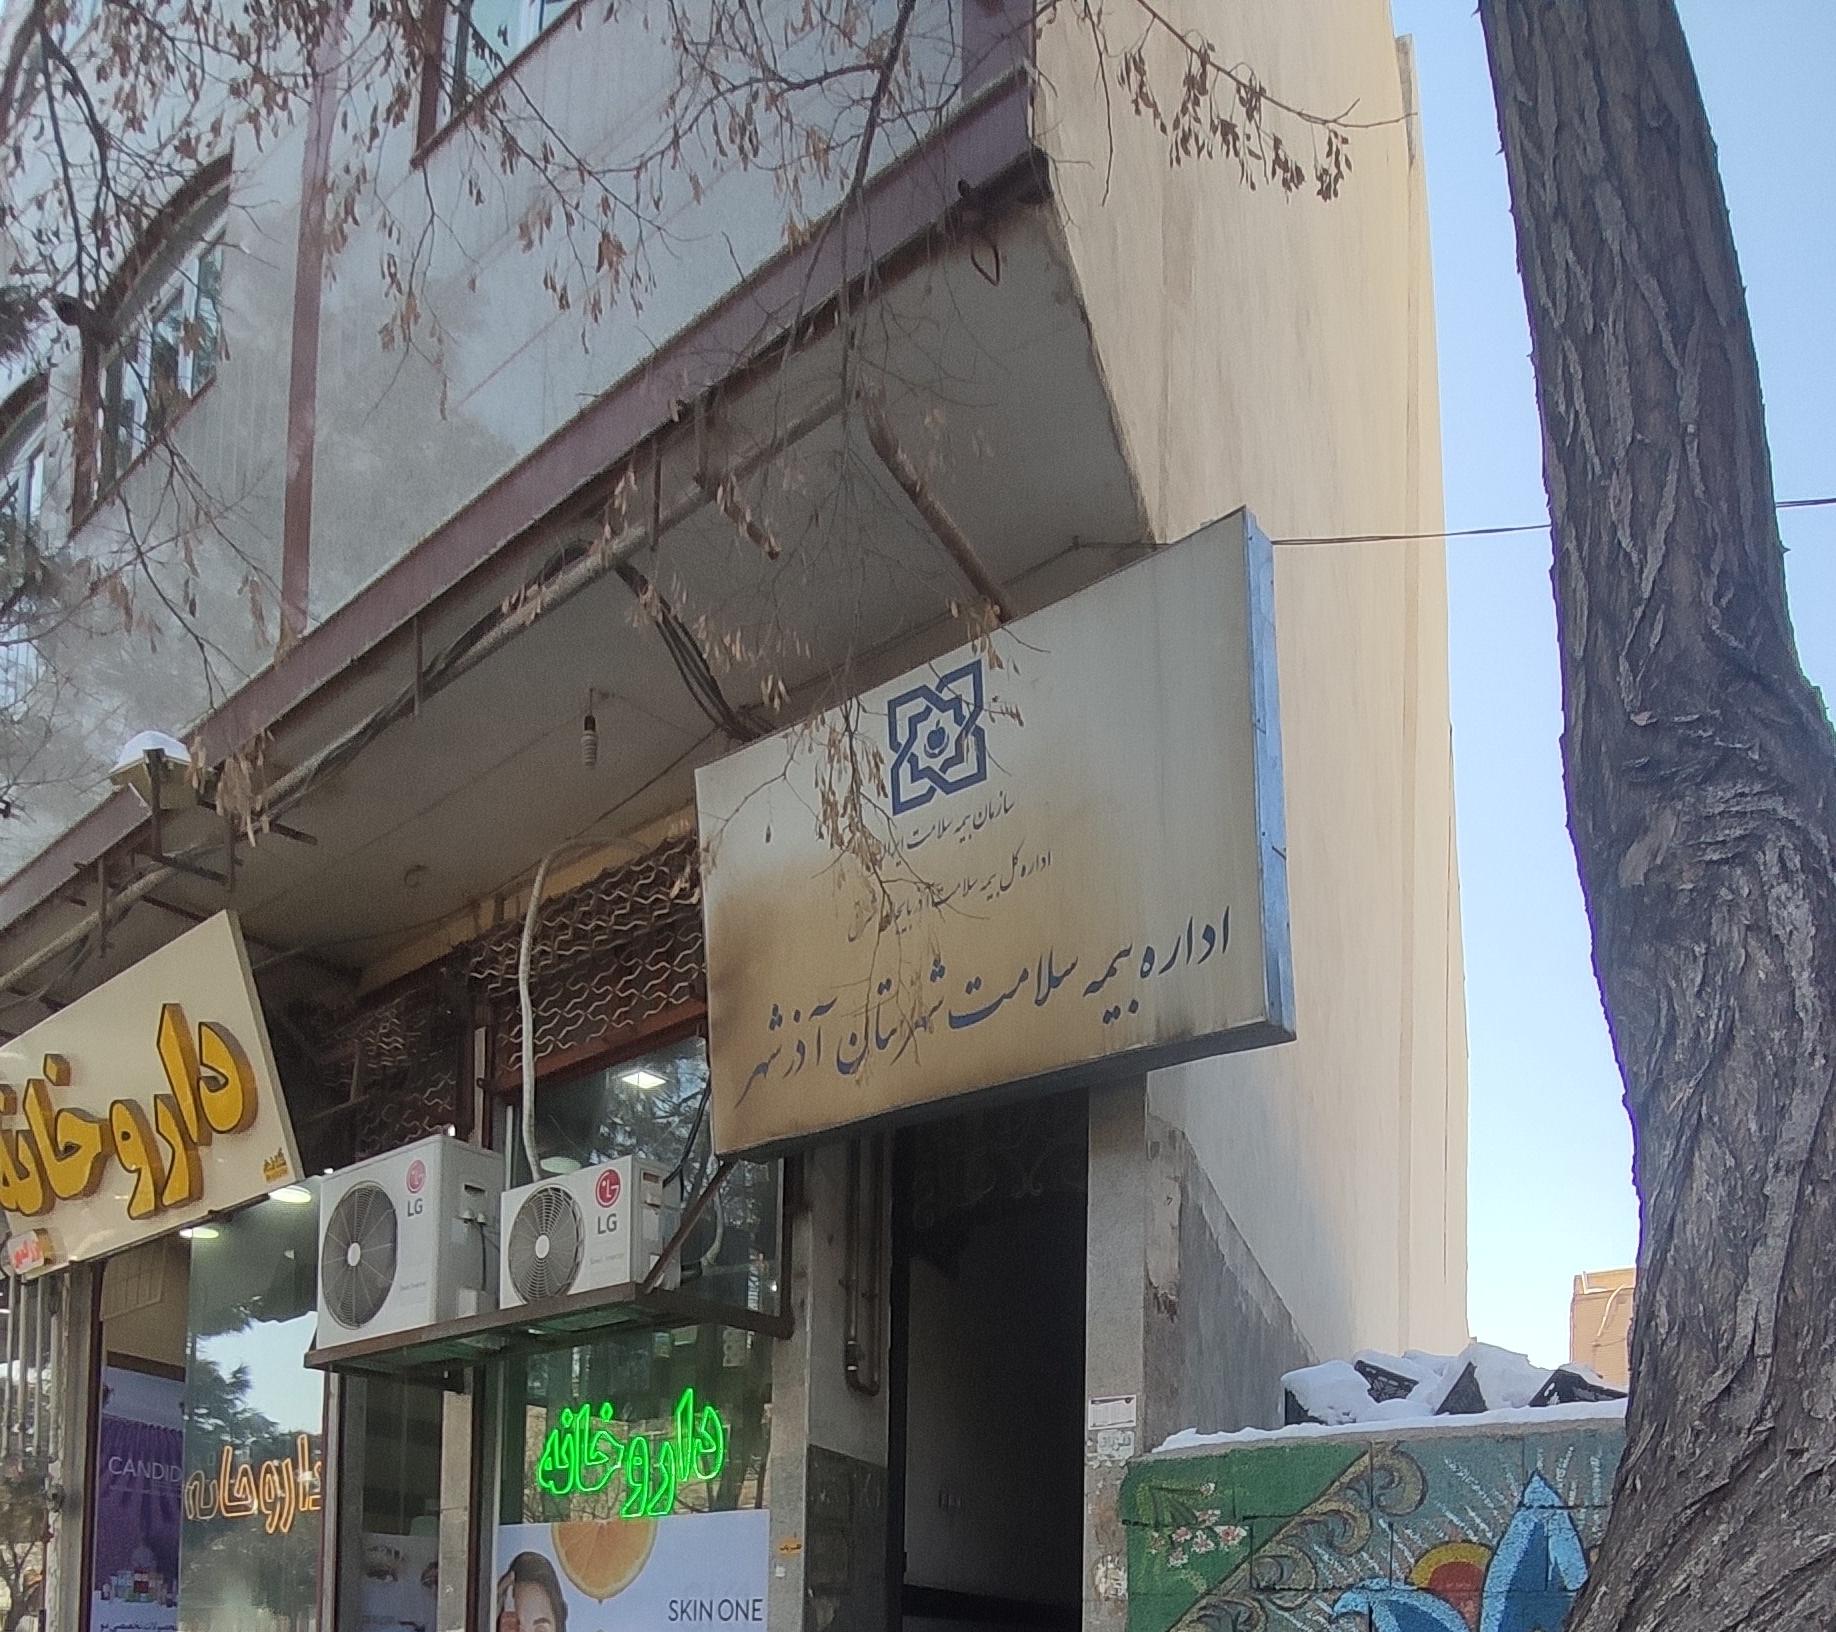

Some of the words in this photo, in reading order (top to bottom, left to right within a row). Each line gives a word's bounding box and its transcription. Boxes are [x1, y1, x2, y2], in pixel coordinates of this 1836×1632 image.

[972, 789, 1015, 830] سازمان
[906, 820, 953, 850] سلامت
[953, 813, 972, 843] بیمه
[1000, 838, 1025, 892] کل
[1020, 850, 1051, 878] اداره
[979, 872, 1000, 901] بیمه
[1138, 904, 1230, 980] اداره
[948, 947, 1079, 1030] سلامت
[1082, 941, 1140, 1026] بیمه
[836, 958, 946, 1076] شهرستان
[733, 995, 840, 1109] آذرشهر
[407, 1197, 423, 1218] LG
[596, 1212, 618, 1235] LG
[108, 1455, 183, 1483] CANDID
[539, 1386, 725, 1518] داروخانه
[667, 1598, 714, 1623] SKIN
[717, 1598, 764, 1623] ONE
